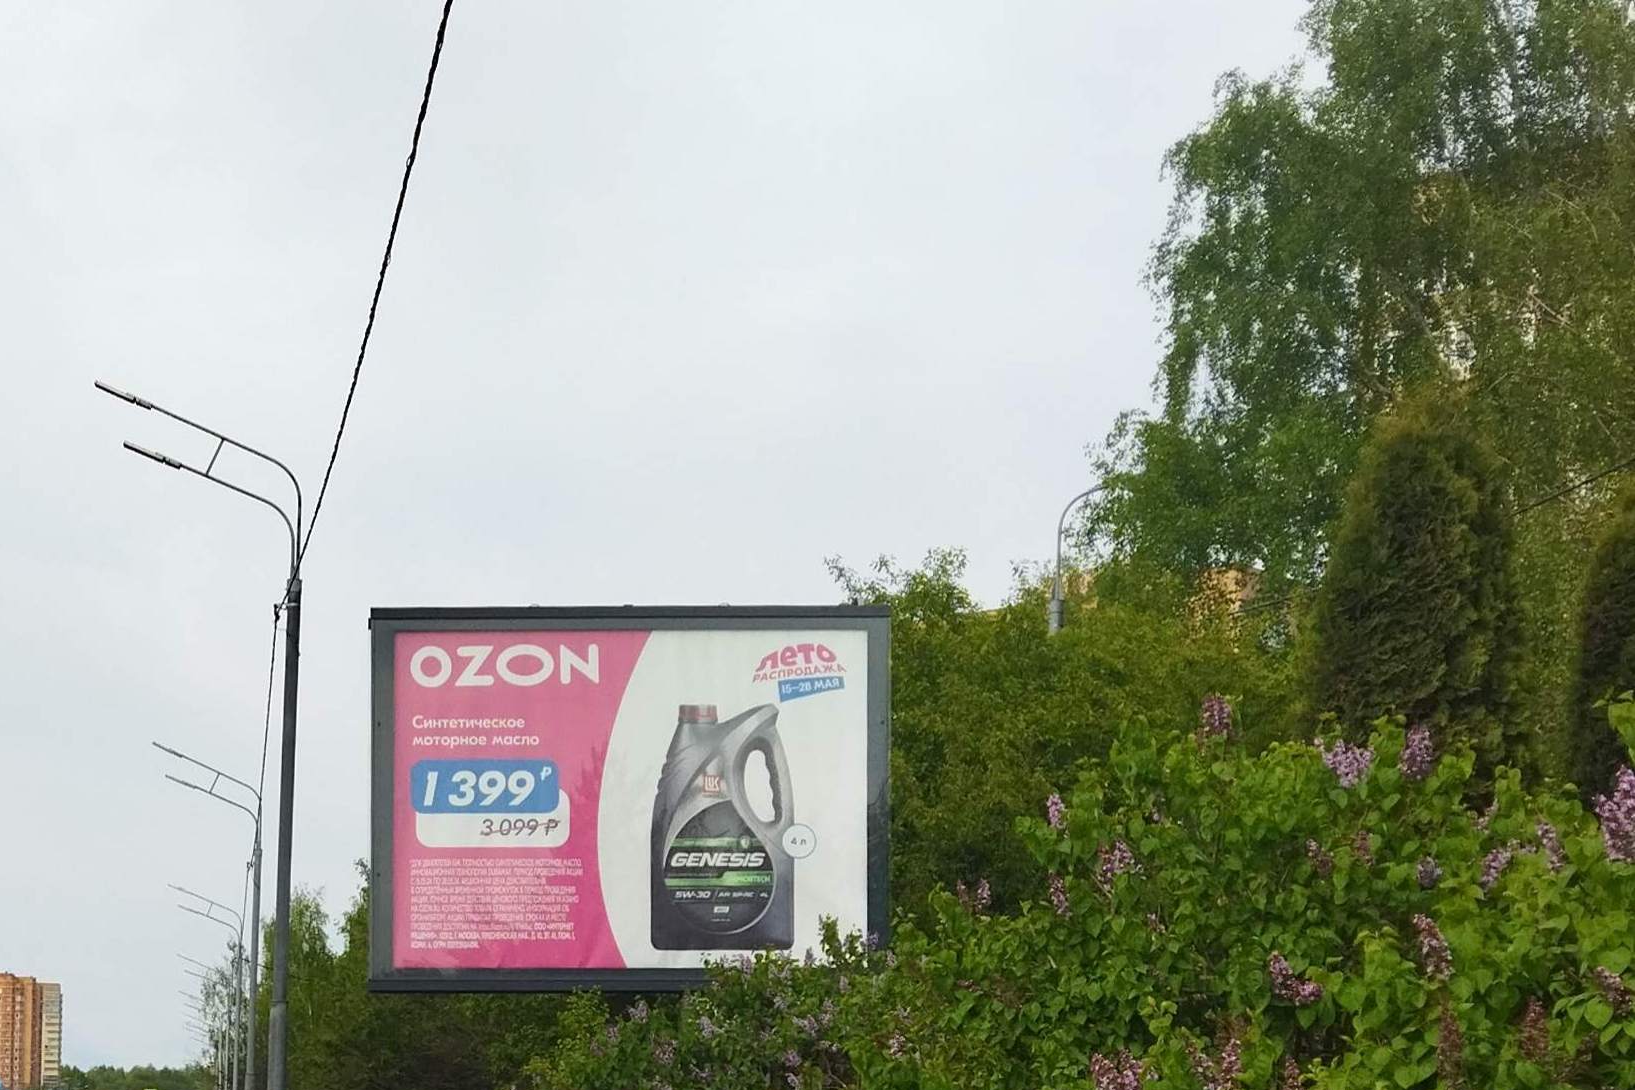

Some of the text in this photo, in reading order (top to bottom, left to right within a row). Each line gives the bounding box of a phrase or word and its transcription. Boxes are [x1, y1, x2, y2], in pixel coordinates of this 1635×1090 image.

[410, 643, 600, 688] OZON
[752, 663, 848, 683] РАСПРОДАЖА
[813, 678, 841, 691] МАЯ
[412, 715, 526, 729] Синтетическое
[412, 735, 540, 749] моторное масло
[670, 852, 766, 868] GENESIS
[674, 890, 712, 899] 5W-30
